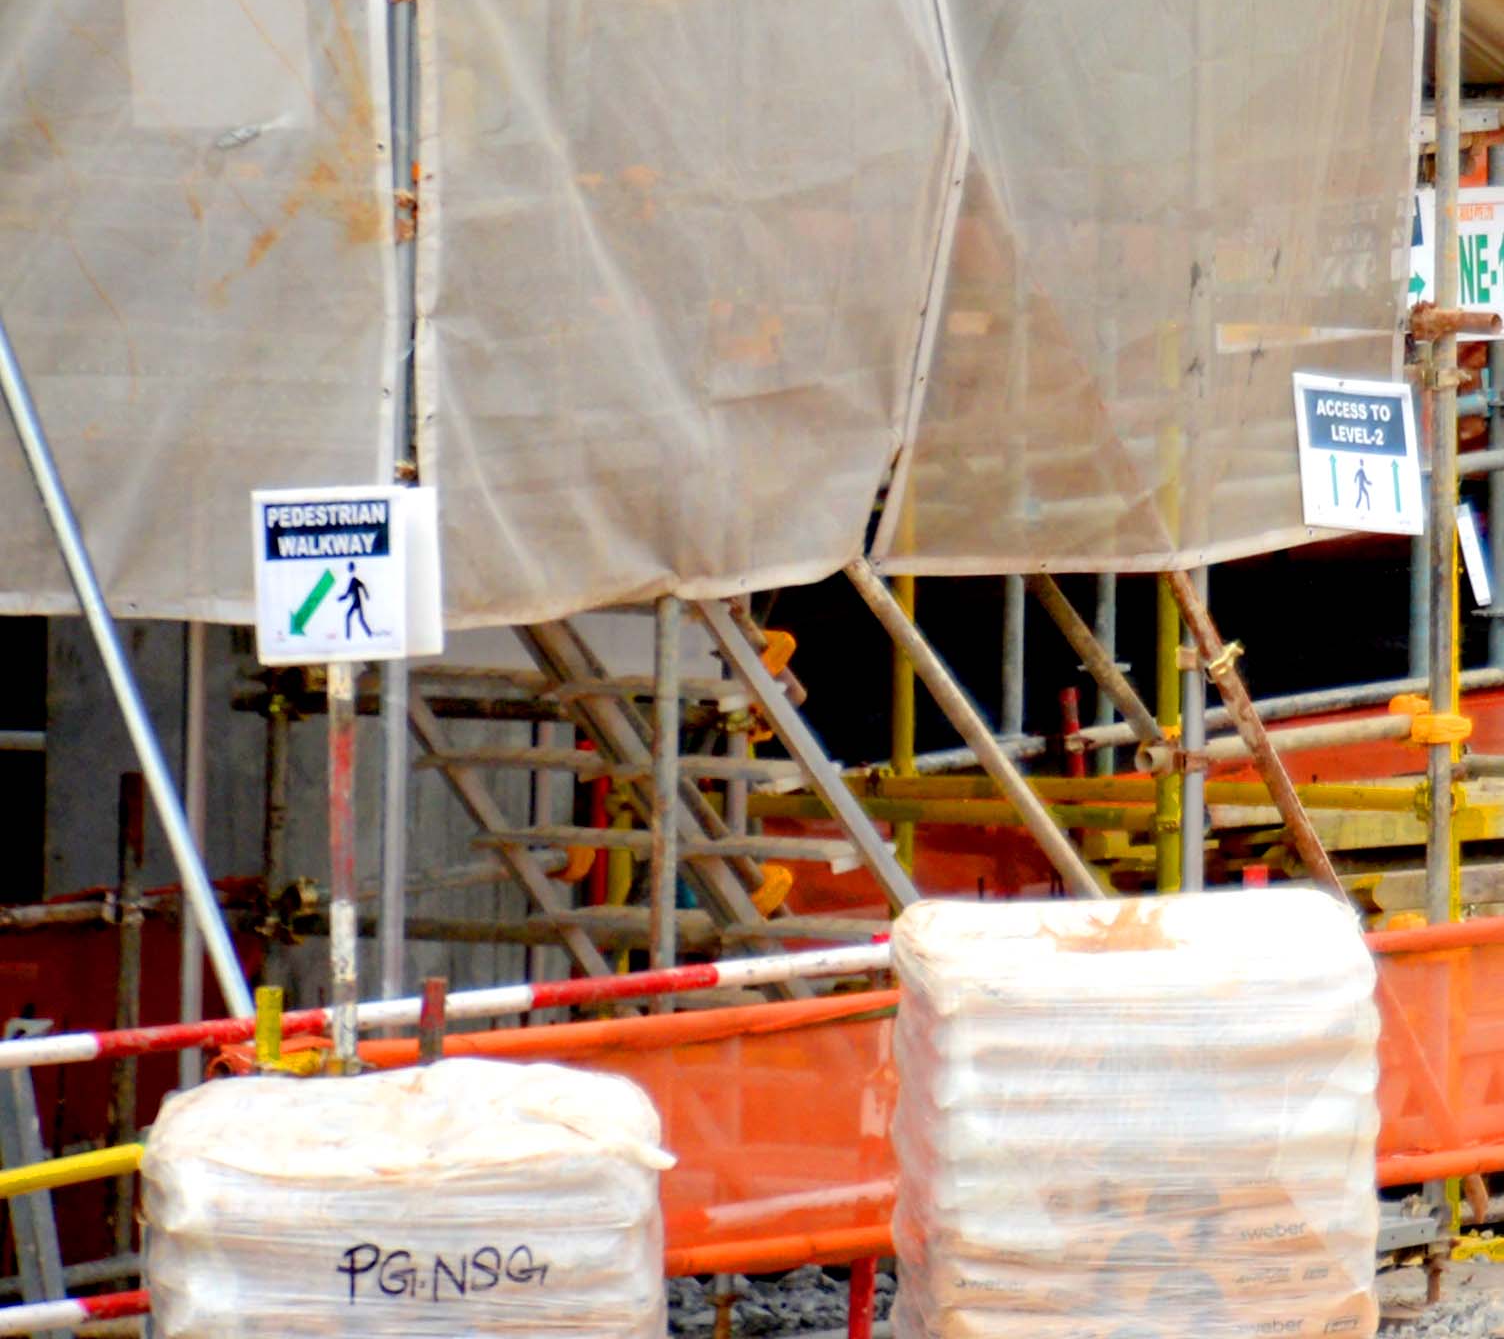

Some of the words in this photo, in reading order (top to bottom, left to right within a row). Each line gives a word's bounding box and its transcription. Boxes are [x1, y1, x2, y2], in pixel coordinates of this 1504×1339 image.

[1316, 399, 1367, 419] ACCESS
[1370, 405, 1391, 422] TO
[1331, 424, 1384, 445] LEVEL-2
[267, 503, 386, 528] PEDESTRIAN
[277, 531, 377, 557] WALKWAY
